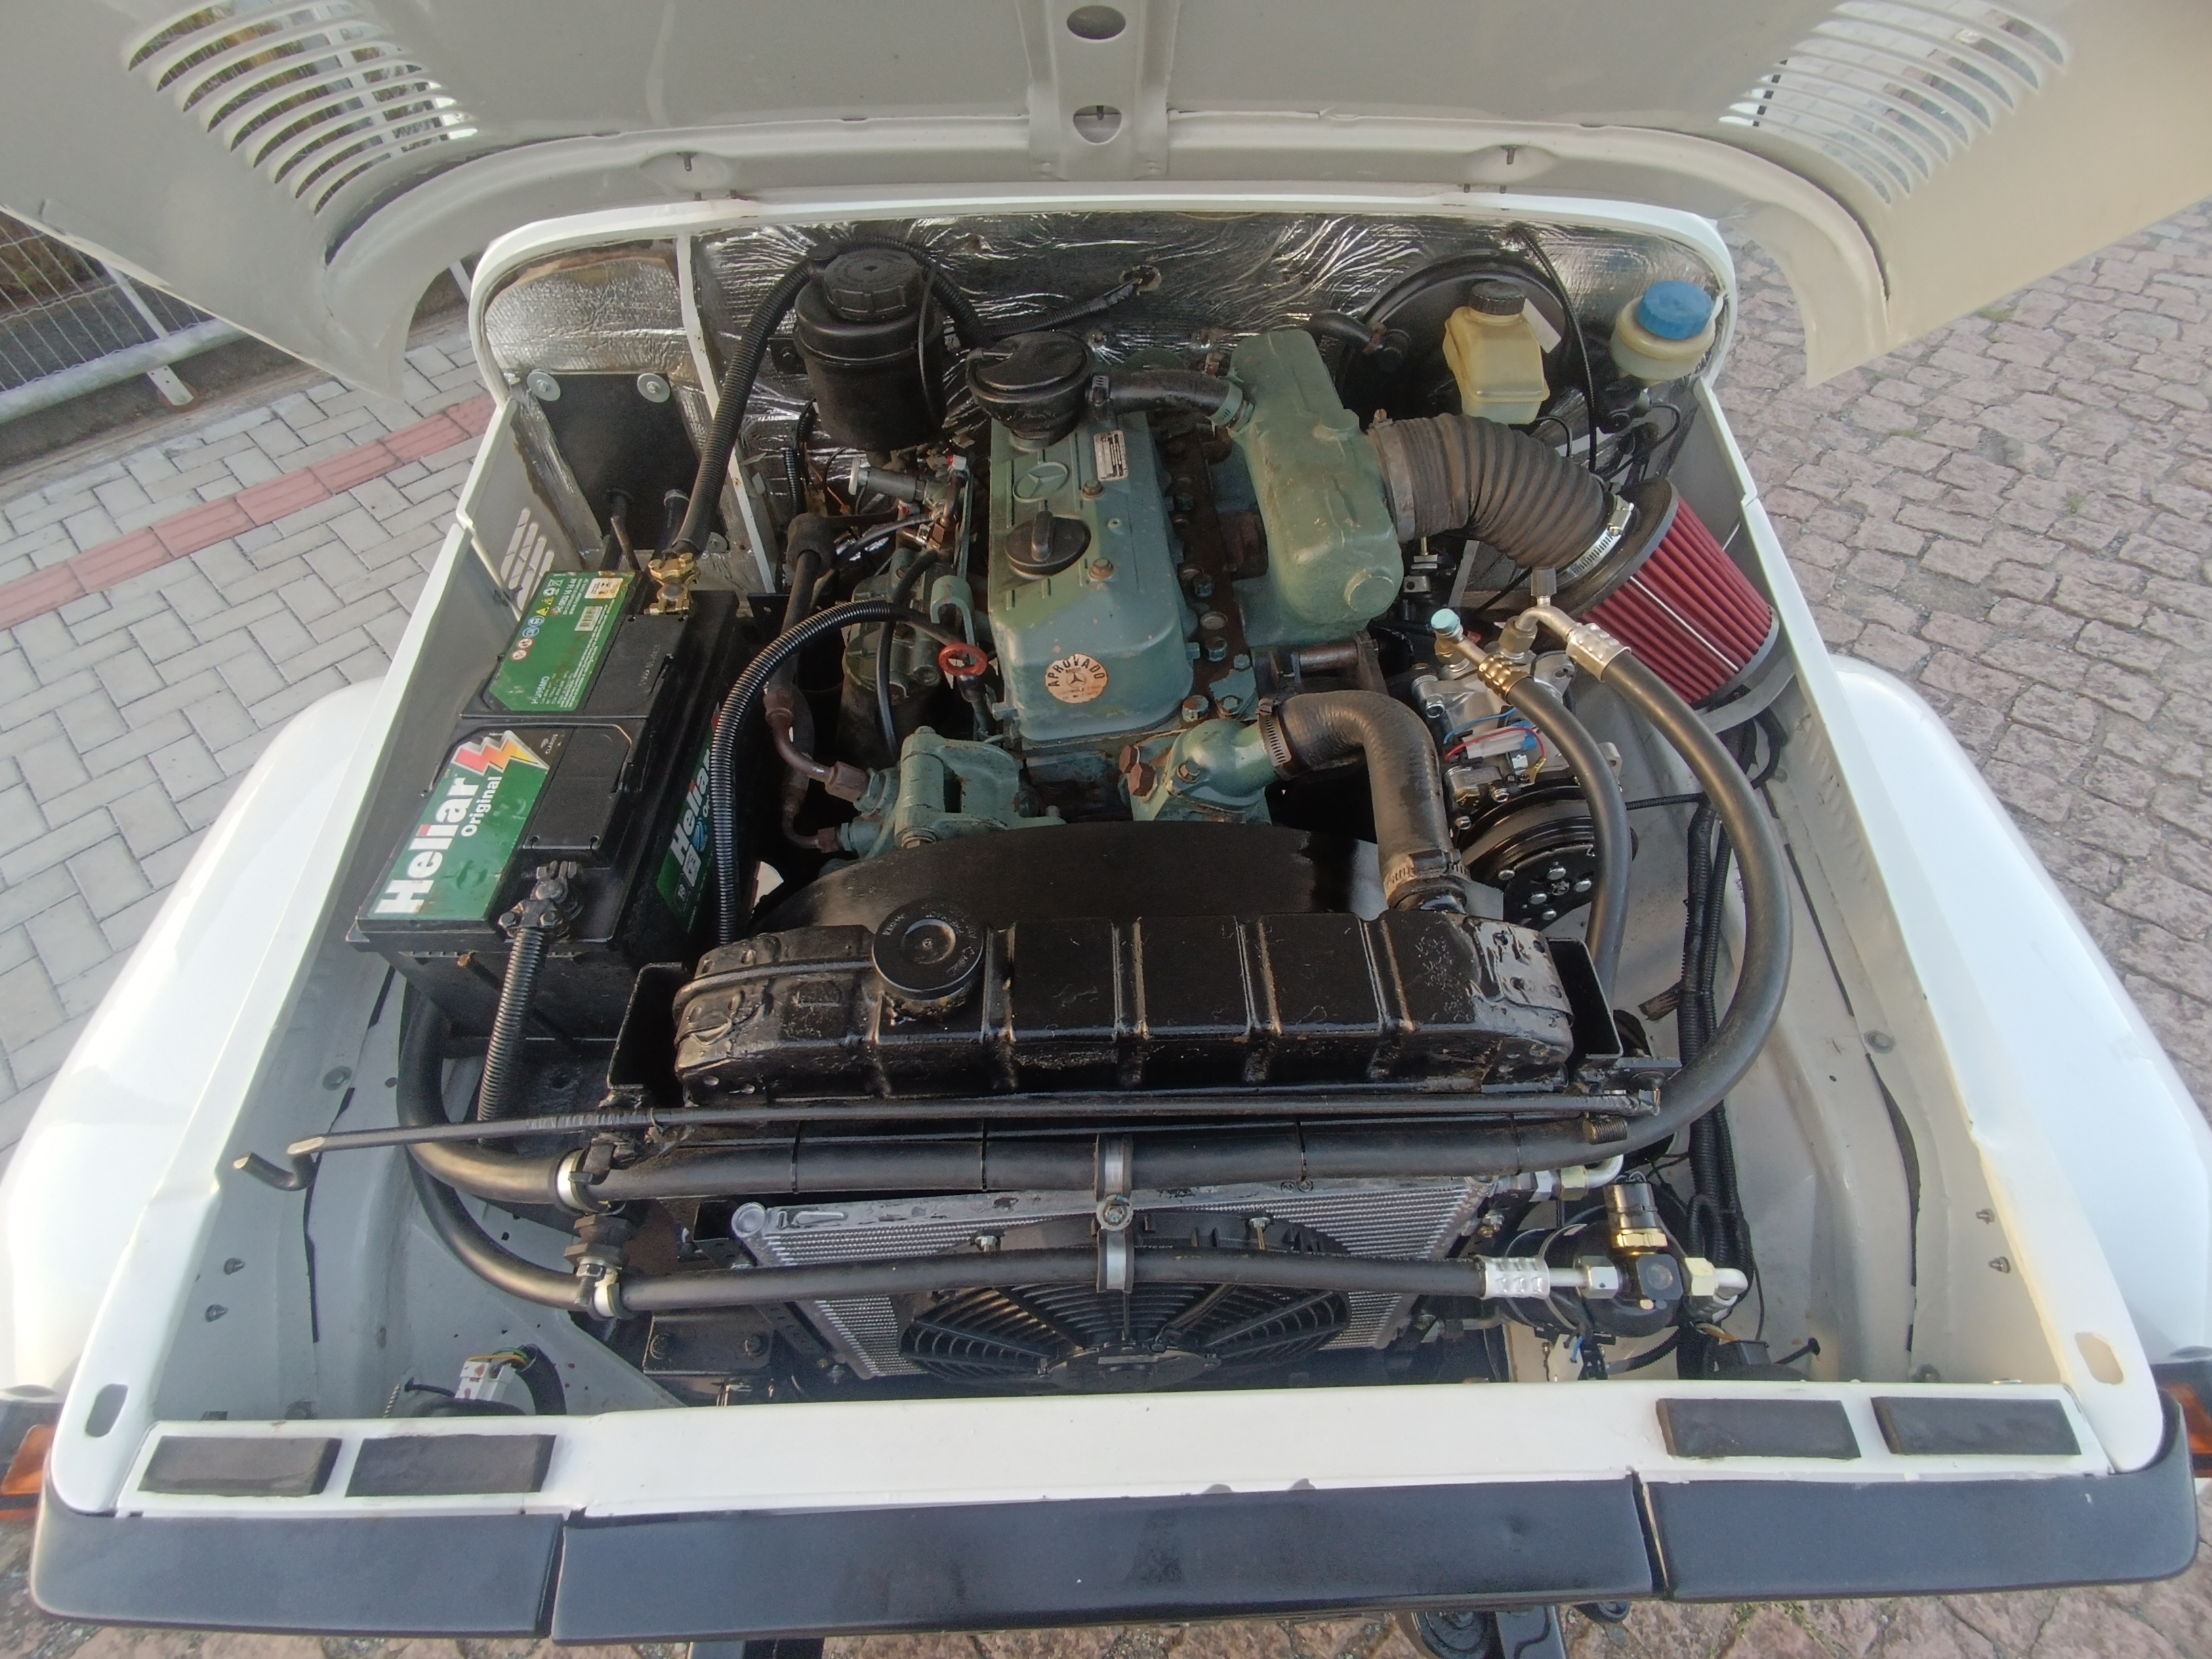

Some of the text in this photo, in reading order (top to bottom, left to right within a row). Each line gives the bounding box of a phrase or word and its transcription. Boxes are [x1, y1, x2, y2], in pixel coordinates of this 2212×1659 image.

[545, 733, 558, 754] CLARIOS
[461, 777, 503, 837] Original
[374, 777, 479, 914] Heliar
